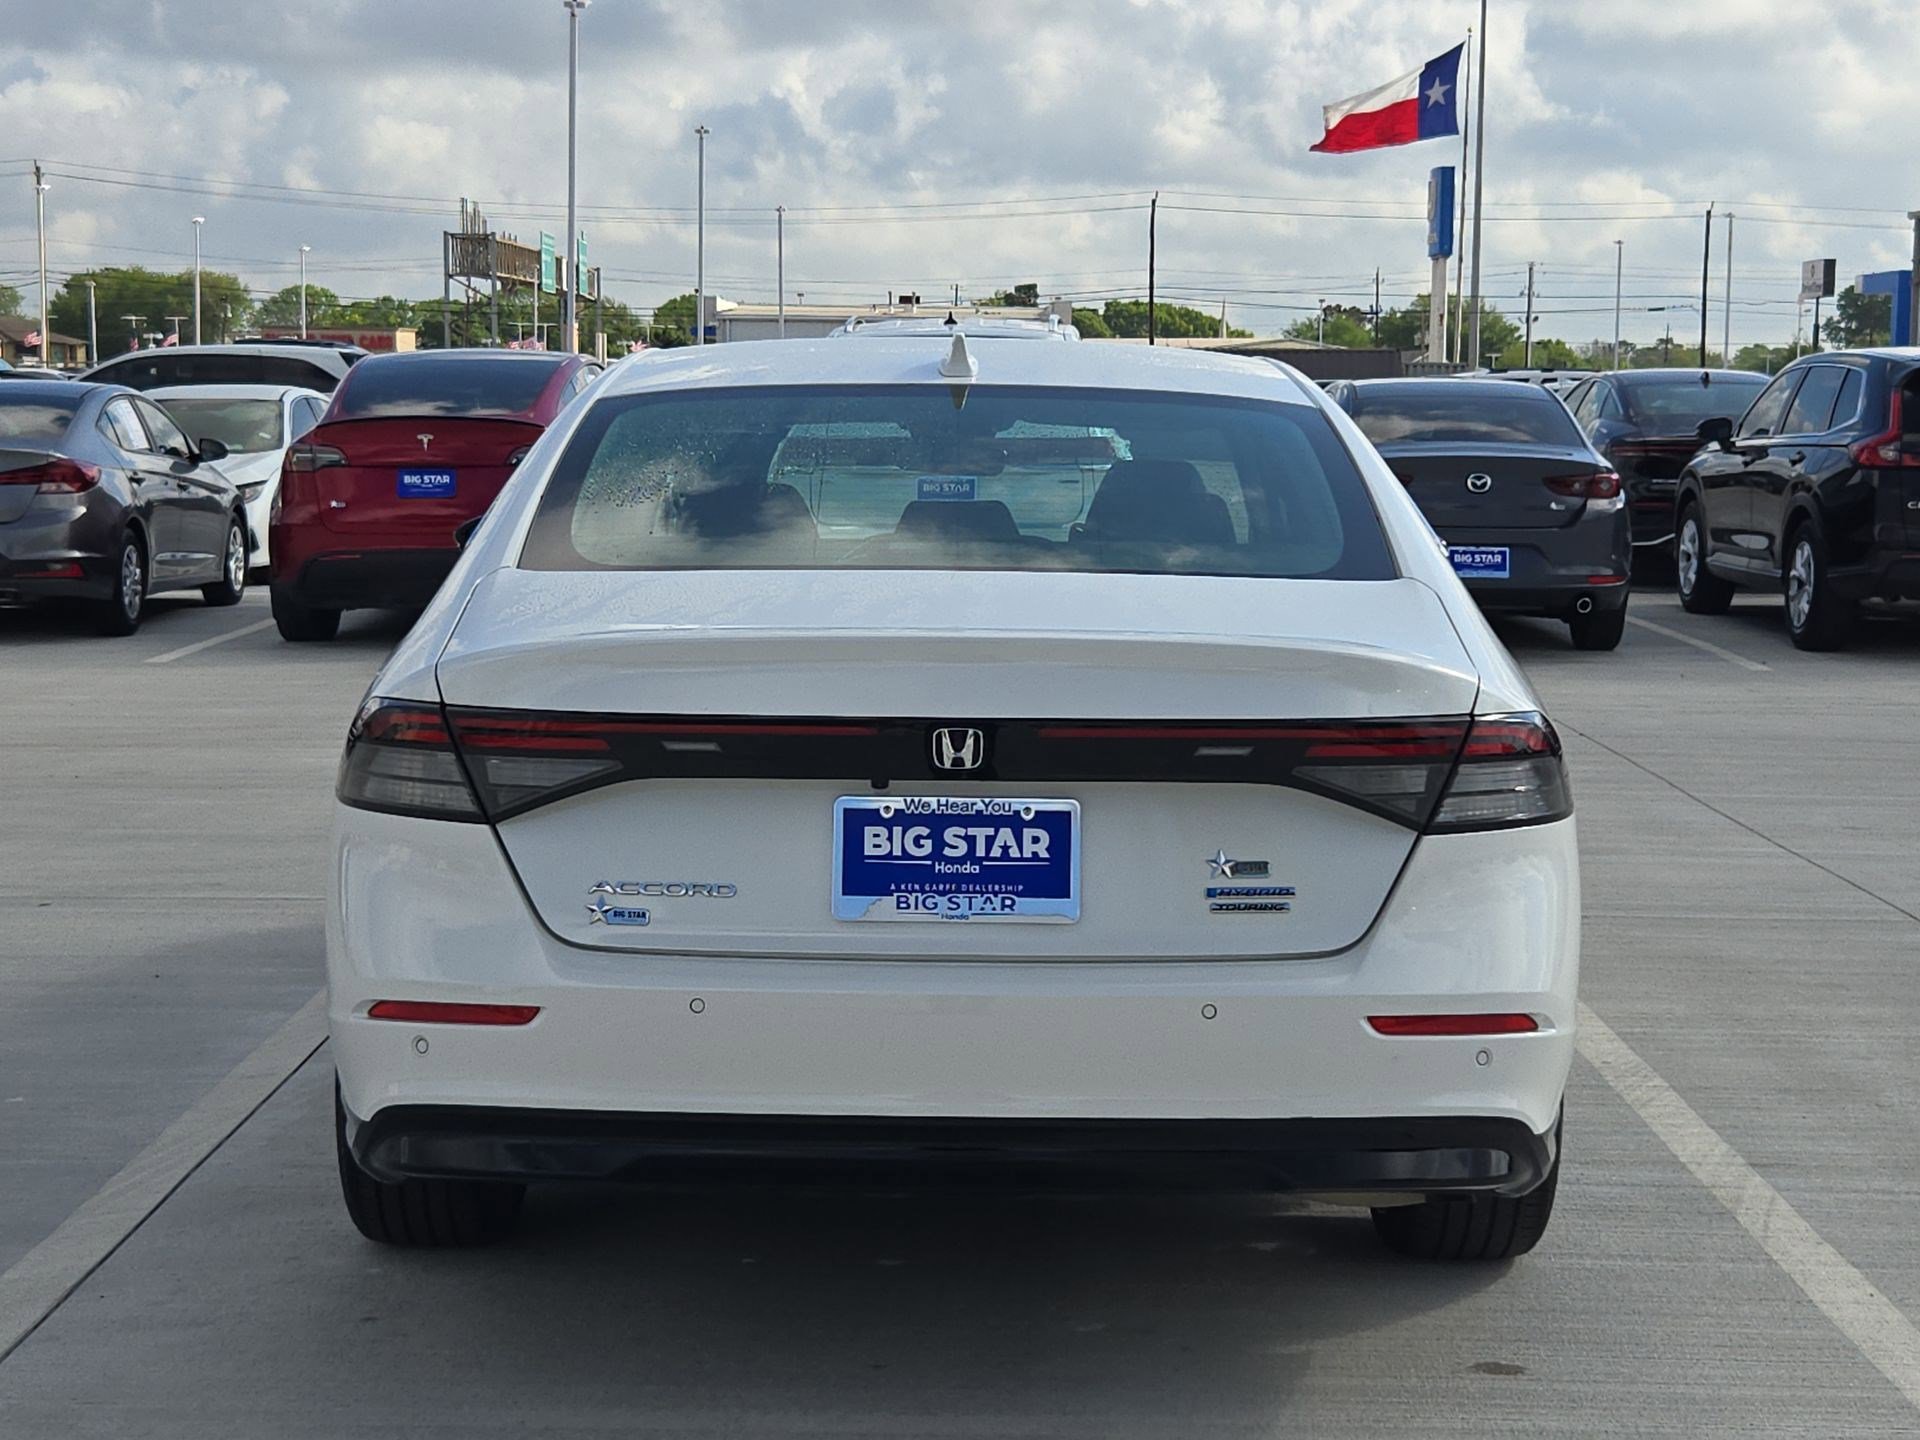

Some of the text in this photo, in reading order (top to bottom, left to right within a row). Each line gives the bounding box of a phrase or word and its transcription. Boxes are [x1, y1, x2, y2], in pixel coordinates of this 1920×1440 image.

[403, 475, 450, 484] BIG STAR
[1454, 554, 1502, 563] BIG STAR
[903, 798, 1012, 815] We Hear You
[864, 826, 1051, 858] BIG STAR
[935, 861, 980, 874] Honda
[589, 881, 737, 898] ACCORD
[901, 883, 920, 891] KEN
[961, 884, 1024, 892] DEALERSHIP
[1217, 886, 1296, 899] HYBRID
[896, 895, 1017, 911] BIG STAR
[1210, 902, 1290, 913] TOURING
[628, 911, 647, 919] STAR
